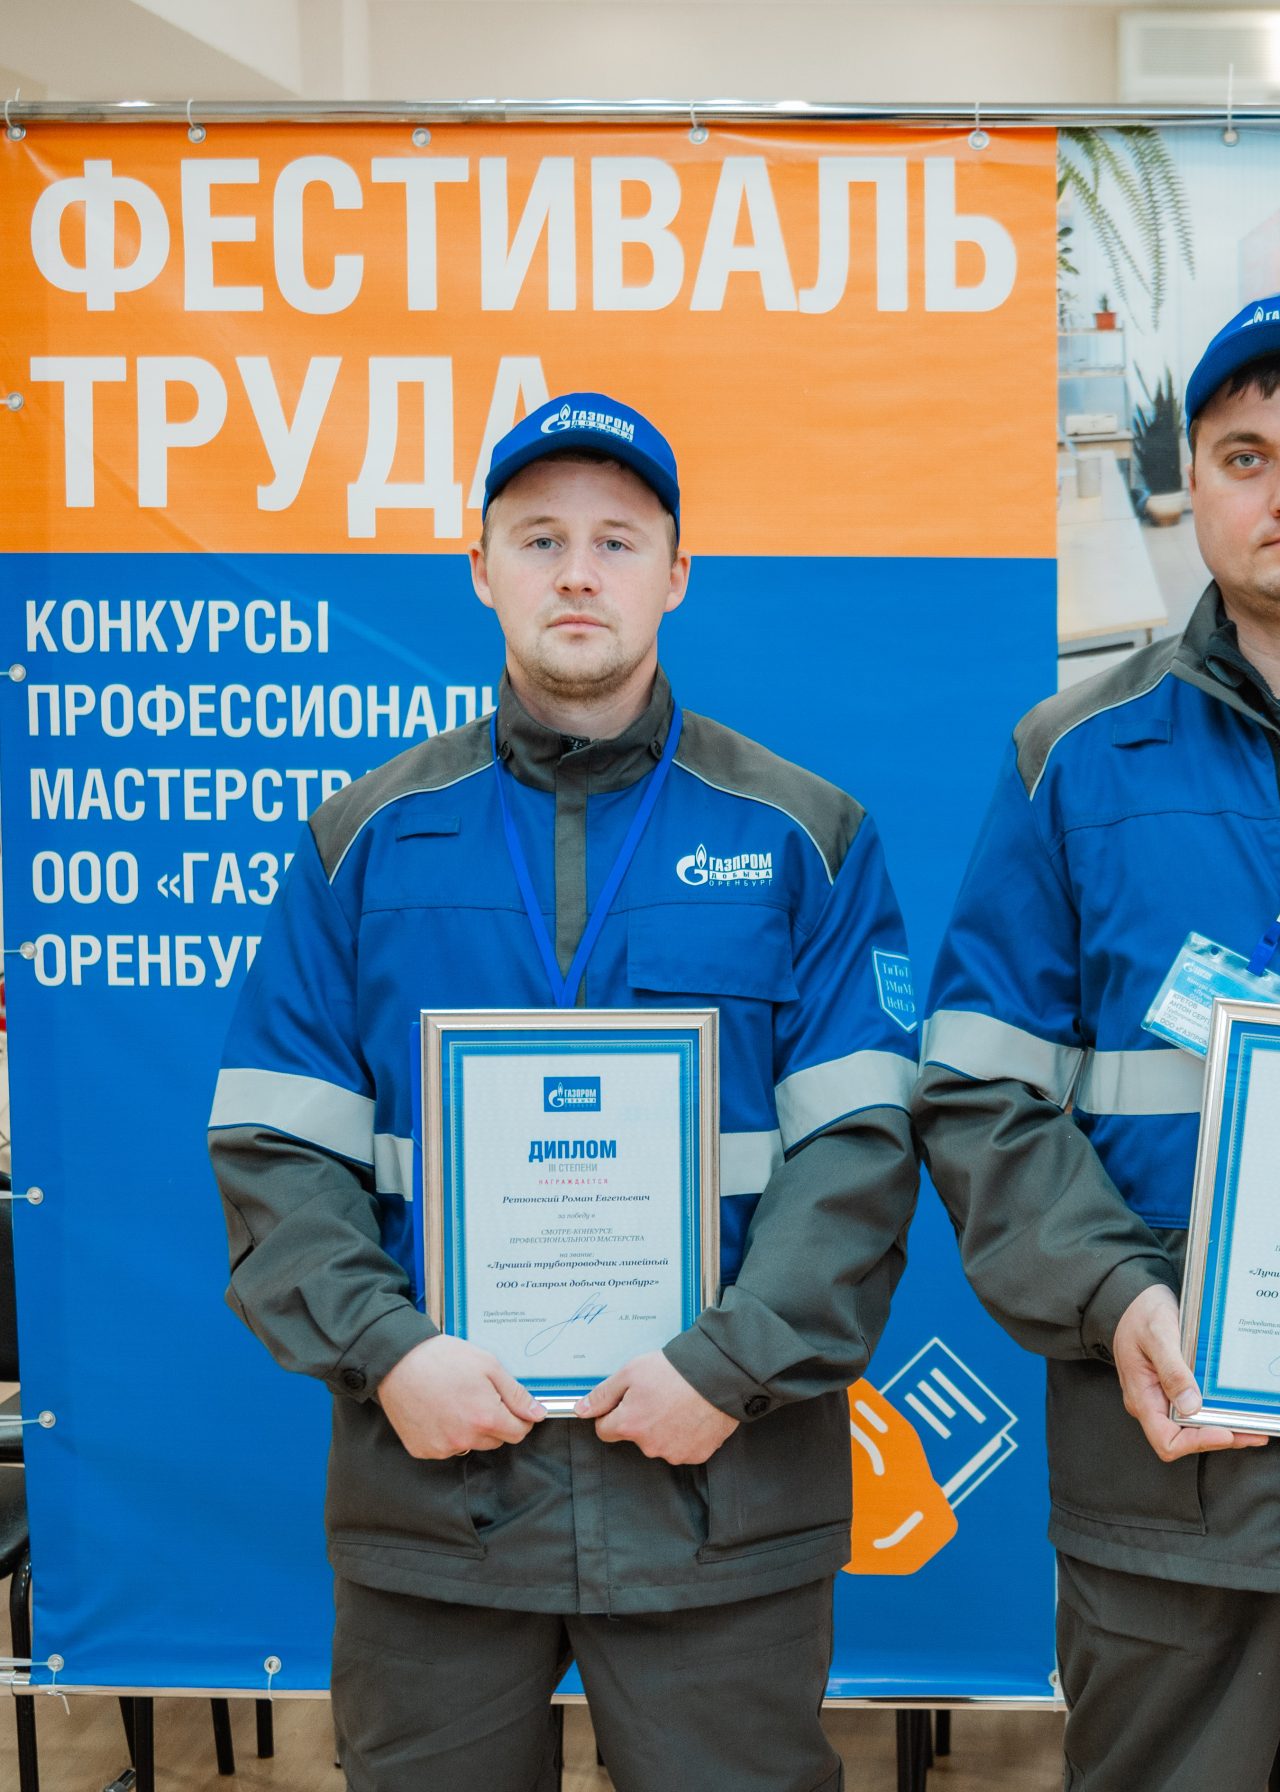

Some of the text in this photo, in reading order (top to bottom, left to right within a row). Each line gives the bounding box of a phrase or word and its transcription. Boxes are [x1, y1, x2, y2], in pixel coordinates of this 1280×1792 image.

[30, 156, 1018, 314] ФЕСТИВАЛЬ
[572, 410, 635, 434] ГАЗПРОМ
[25, 599, 329, 654] КОНКУРСЫ
[709, 852, 772, 871] ГАЗПРОМ
[31, 851, 295, 905] ООО «ГАЗ
[711, 869, 771, 879] ДОБЫЧА
[564, 1089, 596, 1098] ГАЗПРОМ
[528, 1140, 617, 1163] ДИПЛОМ
[558, 1163, 598, 1173] СТЕПЕНИ
[561, 1195, 593, 1203] Роман
[541, 1228, 613, 1236] СМОТРЕ-КОНКУРСЕ
[509, 1236, 596, 1244] ПРОФЕССИОНАЛЬНОГО
[487, 1257, 669, 1271] «Лучший трубопроводчик линейный
[496, 1278, 659, 1290] ООО «Газпром добыча Оренбург»
[1256, 1289, 1279, 1299] ООО
